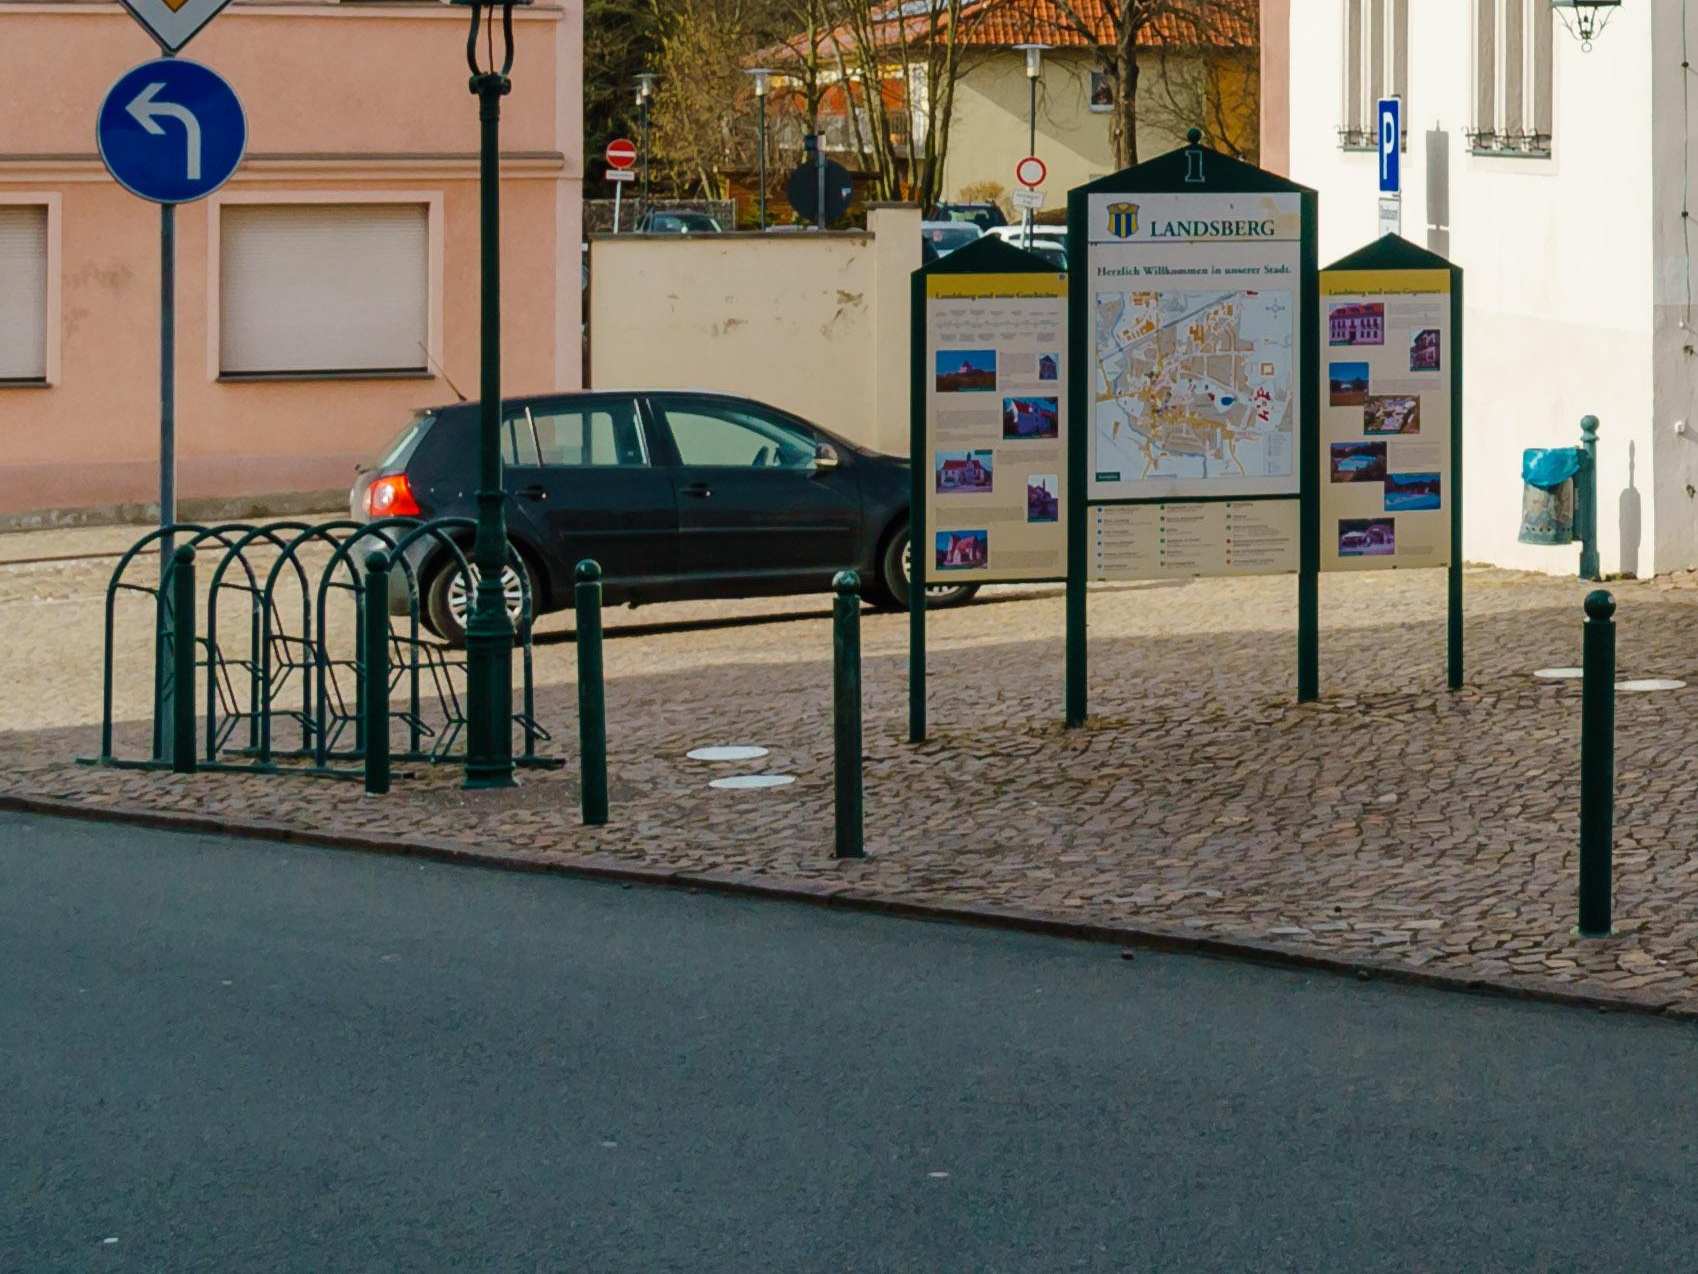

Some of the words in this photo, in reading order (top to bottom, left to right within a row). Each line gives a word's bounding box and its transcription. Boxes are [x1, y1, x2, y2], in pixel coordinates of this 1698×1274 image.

[1382, 111, 1395, 180] P
[1184, 149, 1205, 183] 1
[1150, 219, 1275, 238] LANDSBERG
[1097, 266, 1140, 276] Herzlich
[1143, 265, 1208, 276] Willkommen
[1211, 264, 1222, 275] in
[1224, 267, 1260, 275] unserer
